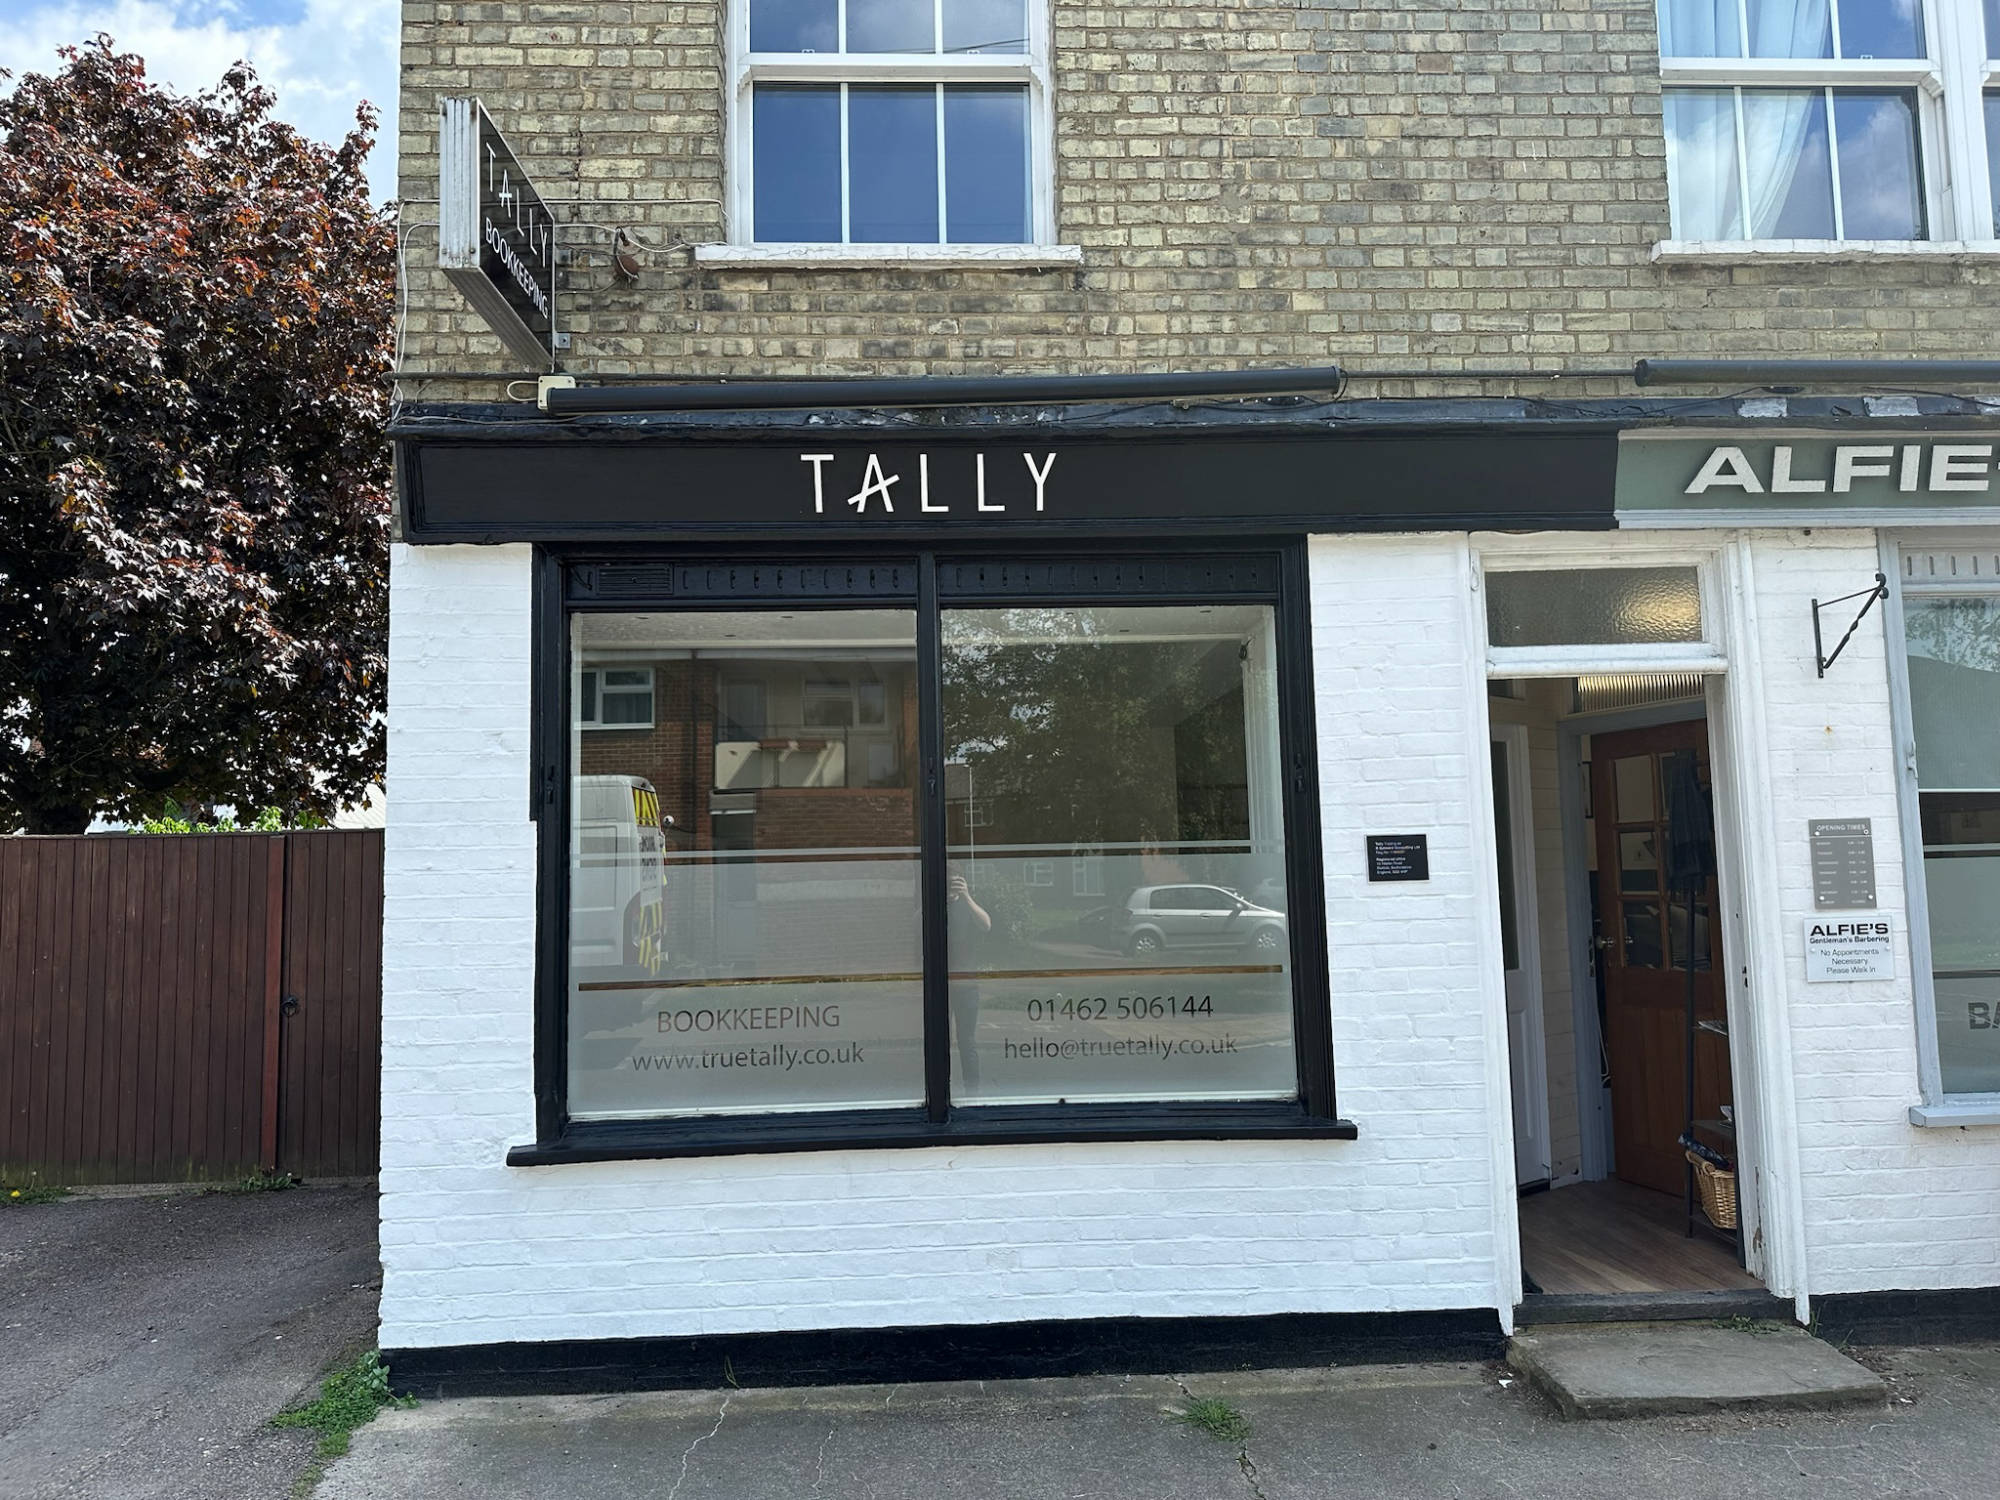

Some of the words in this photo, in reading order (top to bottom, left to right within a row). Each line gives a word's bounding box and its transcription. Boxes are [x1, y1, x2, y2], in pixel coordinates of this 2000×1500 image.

[485, 142, 548, 268] TALLY
[485, 217, 549, 319] BOOKKEEPING
[800, 452, 1057, 513] TALLY
[1684, 444, 2000, 494] ALFIE
[1809, 936, 1853, 944] Gentleman's
[1854, 935, 1889, 944] Barbering
[1810, 923, 1889, 936] ALFIE'S
[1832, 948, 1879, 957] Appointments
[657, 1005, 840, 1033] BOOKKEEPING
[1027, 998, 1108, 1021] 01462
[1117, 995, 1214, 1020] 506144
[1968, 1001, 2000, 1030] B
[632, 1042, 864, 1071] www.truetally.co.uk
[1004, 1033, 1238, 1060] hello@truetally.co.uk
